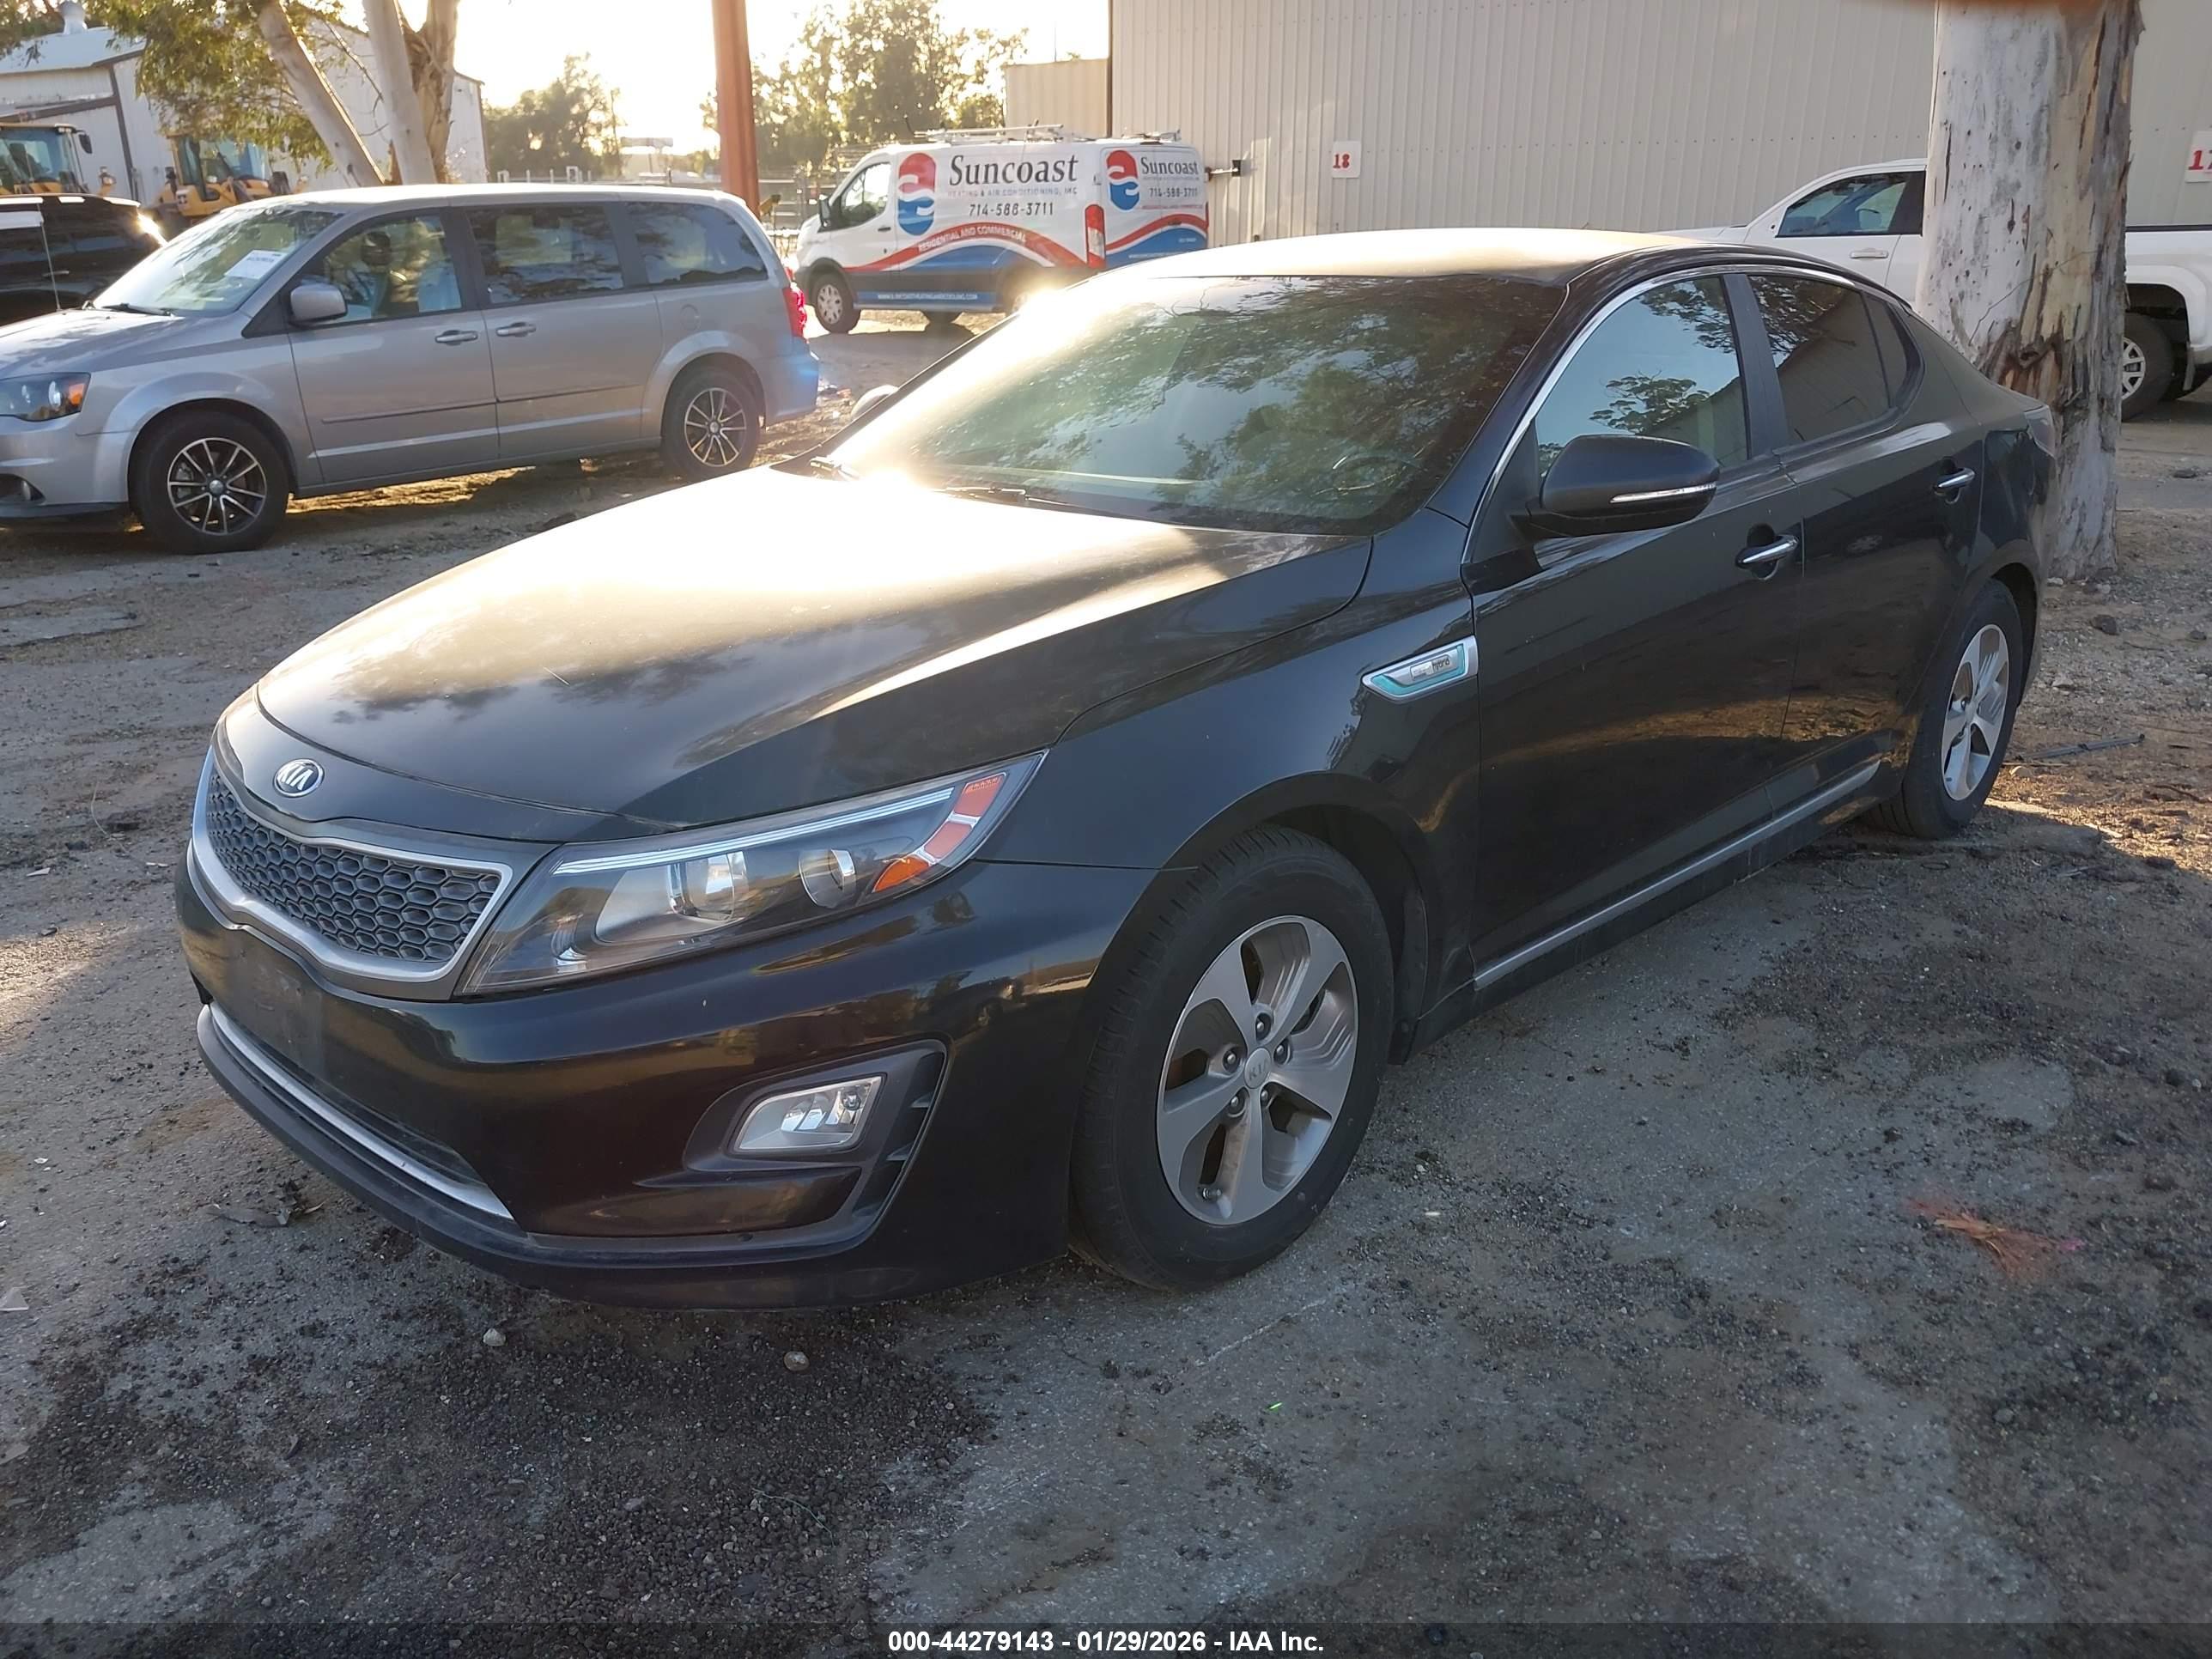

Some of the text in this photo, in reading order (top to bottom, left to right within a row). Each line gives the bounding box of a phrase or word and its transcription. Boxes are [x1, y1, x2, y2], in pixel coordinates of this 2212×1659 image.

[949, 154, 1079, 186] Suncoast
[1140, 156, 1199, 175] Suncoast
[1332, 153, 1351, 169] 18
[969, 202, 1054, 216] 714-588-3711
[918, 225, 1027, 252] RESIDENTIAL AND COMMERCIAL
[1431, 657, 1450, 671] hybrid
[276, 763, 314, 791] KIA
